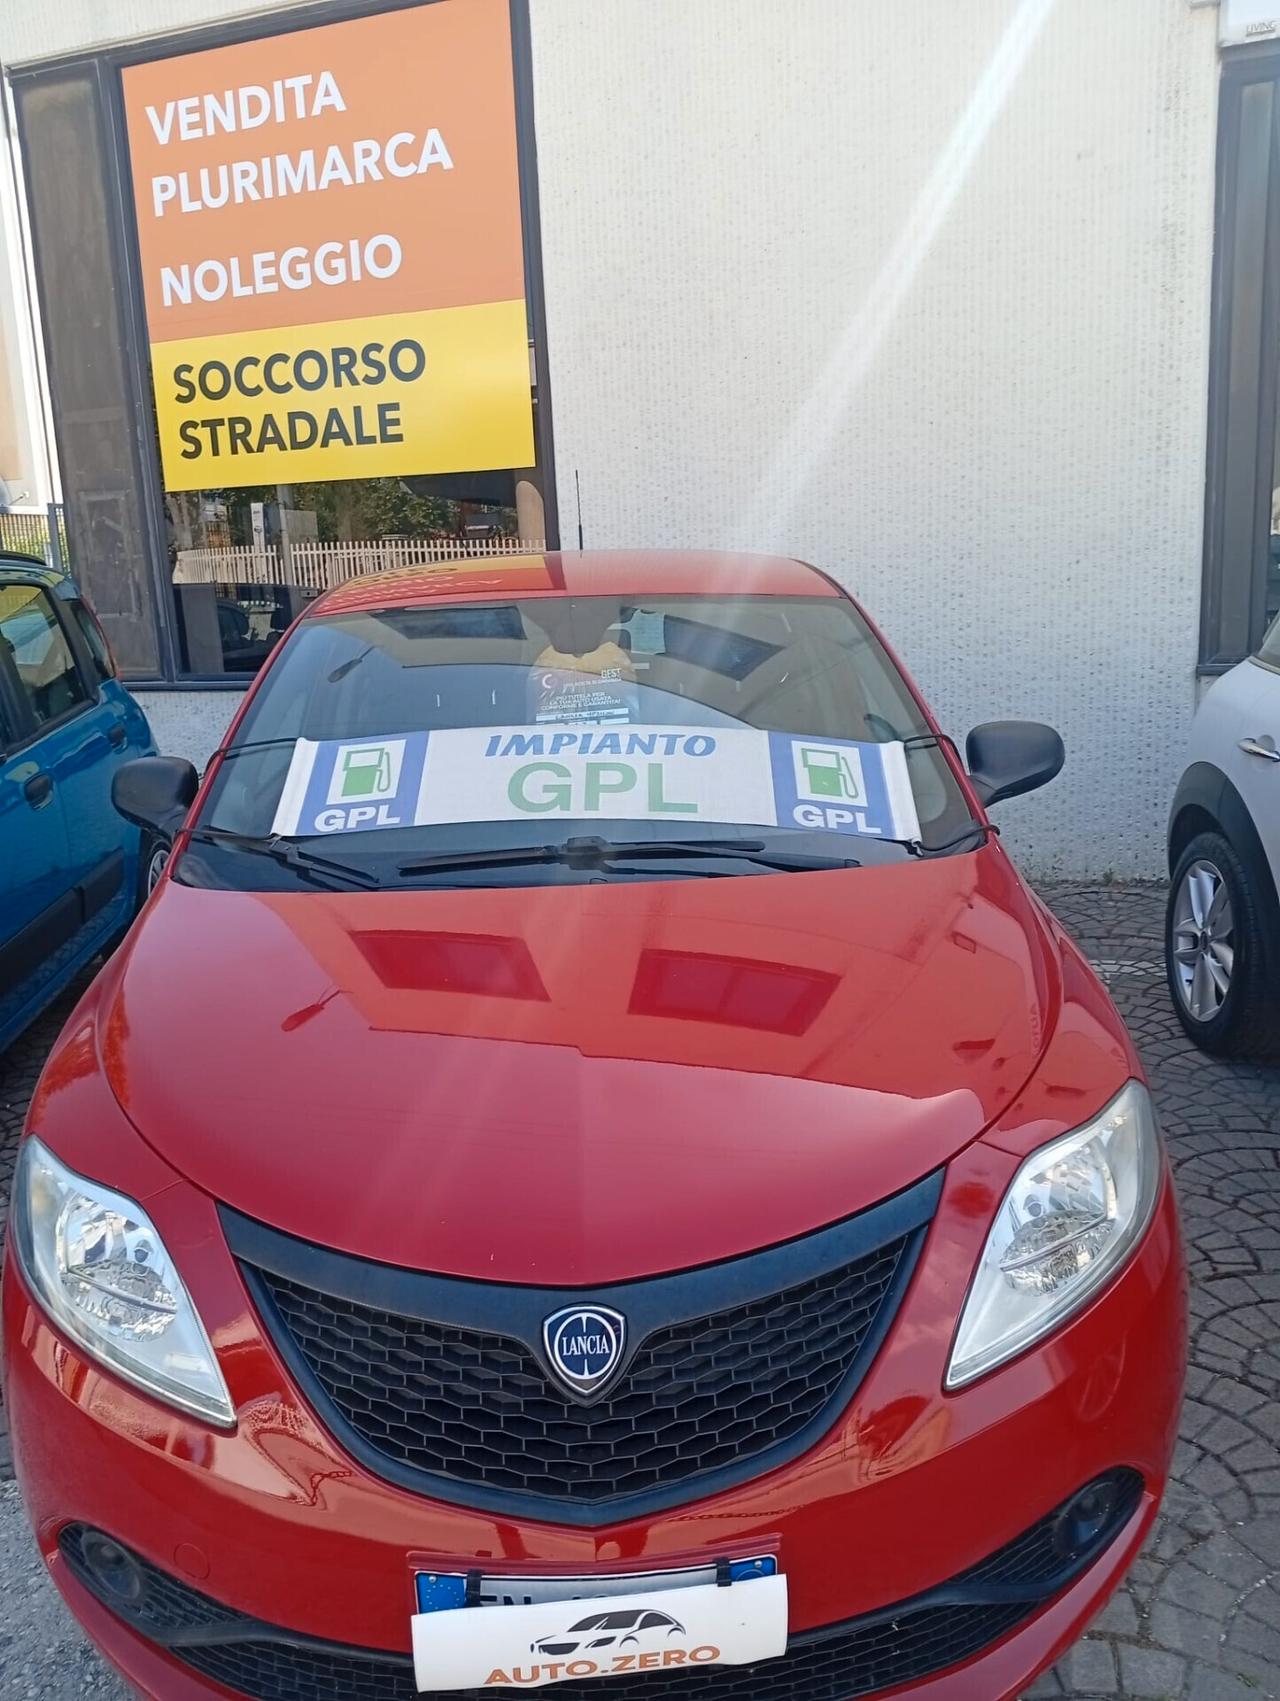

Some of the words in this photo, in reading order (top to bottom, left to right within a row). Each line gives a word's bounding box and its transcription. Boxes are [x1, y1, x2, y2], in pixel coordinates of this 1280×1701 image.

[146, 70, 346, 146] VENDITA
[152, 128, 454, 217] PLURIMARCA
[161, 234, 402, 307] NOLEGGIO
[173, 339, 426, 404] SOCCORSO
[180, 403, 404, 460] STRADALE
[485, 733, 717, 757] IMPIANTO
[508, 761, 698, 813] GPL
[314, 804, 401, 833] GPL
[792, 804, 882, 834] GPL
[562, 1334, 610, 1356] LANCIA
[483, 1645, 721, 1685] AUTO.ZERO
